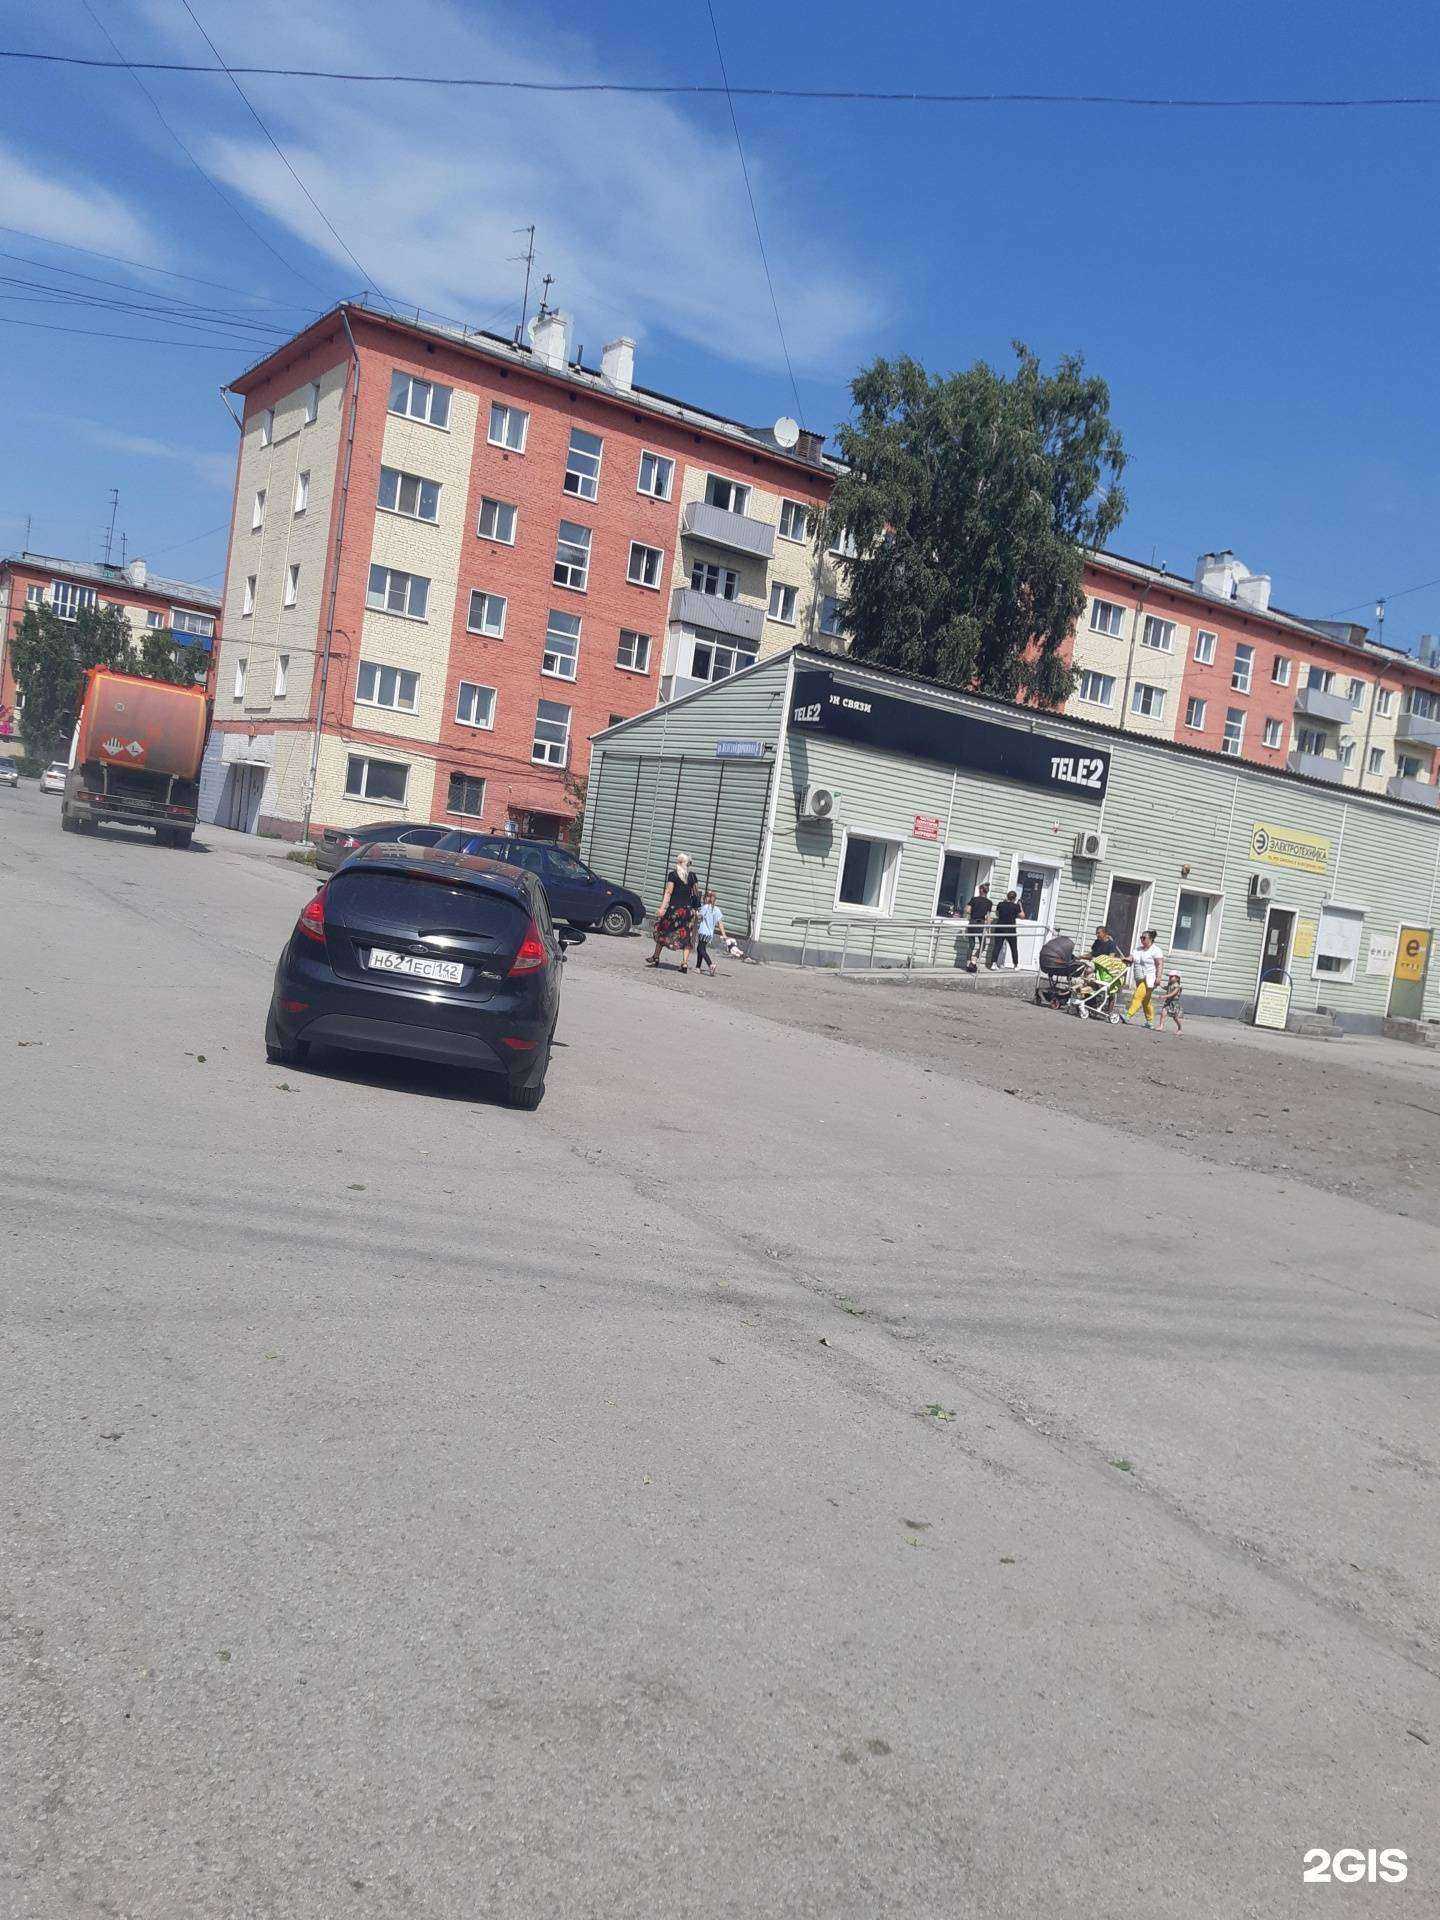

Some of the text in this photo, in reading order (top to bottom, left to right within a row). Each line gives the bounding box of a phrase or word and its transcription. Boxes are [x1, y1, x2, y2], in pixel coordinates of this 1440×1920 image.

[794, 703, 822, 722] TELE2
[1051, 757, 1104, 790] TELE2
[1269, 839, 1328, 859] ЭЛЕКТРОТЕХНИКА
